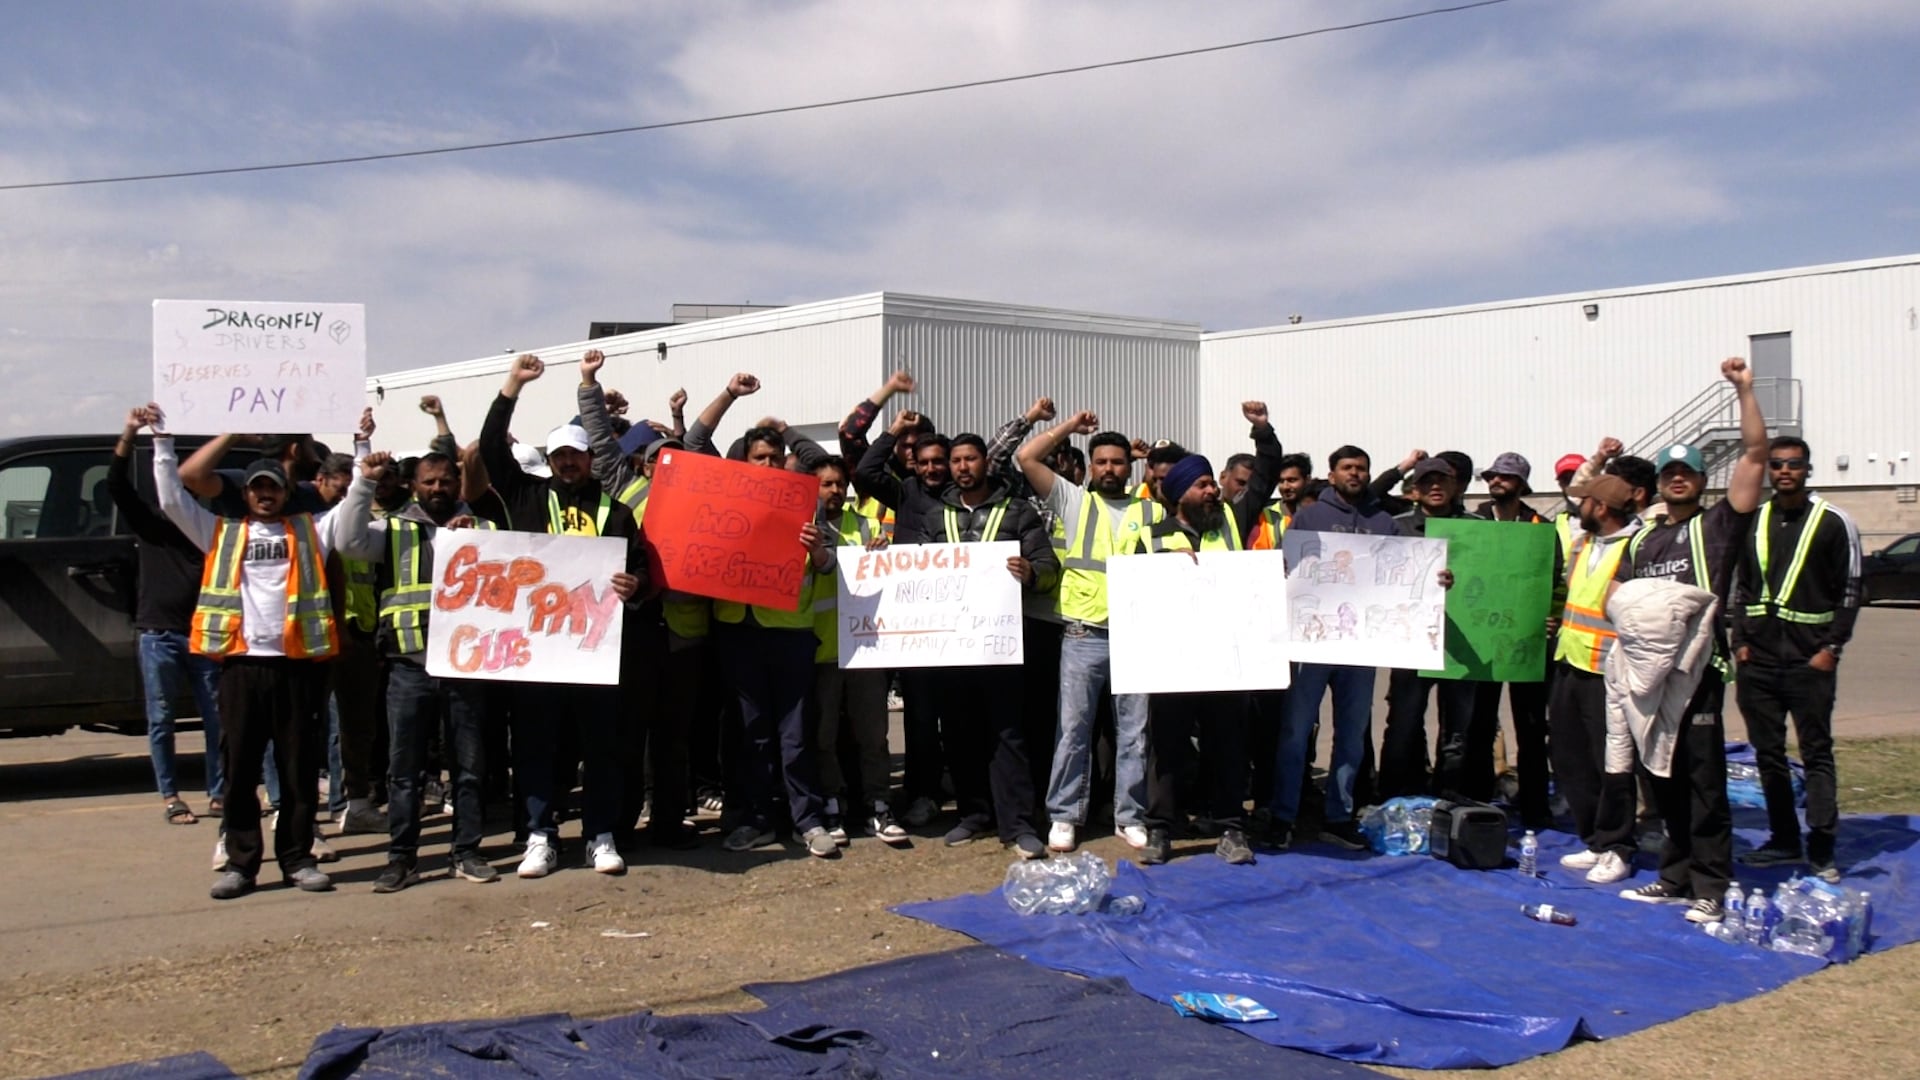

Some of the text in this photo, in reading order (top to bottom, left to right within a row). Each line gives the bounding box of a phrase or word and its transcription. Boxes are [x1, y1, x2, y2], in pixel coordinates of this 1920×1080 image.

[202, 308, 323, 333] DRAGONFLY
[214, 333, 307, 351] DRIVERS
[168, 359, 329, 386] DESERVES FAIR
[228, 387, 286, 413] PAY
[690, 503, 750, 540] AND
[721, 551, 801, 598] STRONG
[855, 546, 971, 581] ENOUGH
[434, 544, 620, 651] STOP PAY
[895, 575, 968, 603] NOW
[901, 636, 949, 656] FAMILY
[958, 637, 976, 649] TO
[983, 634, 1018, 657] FEED
